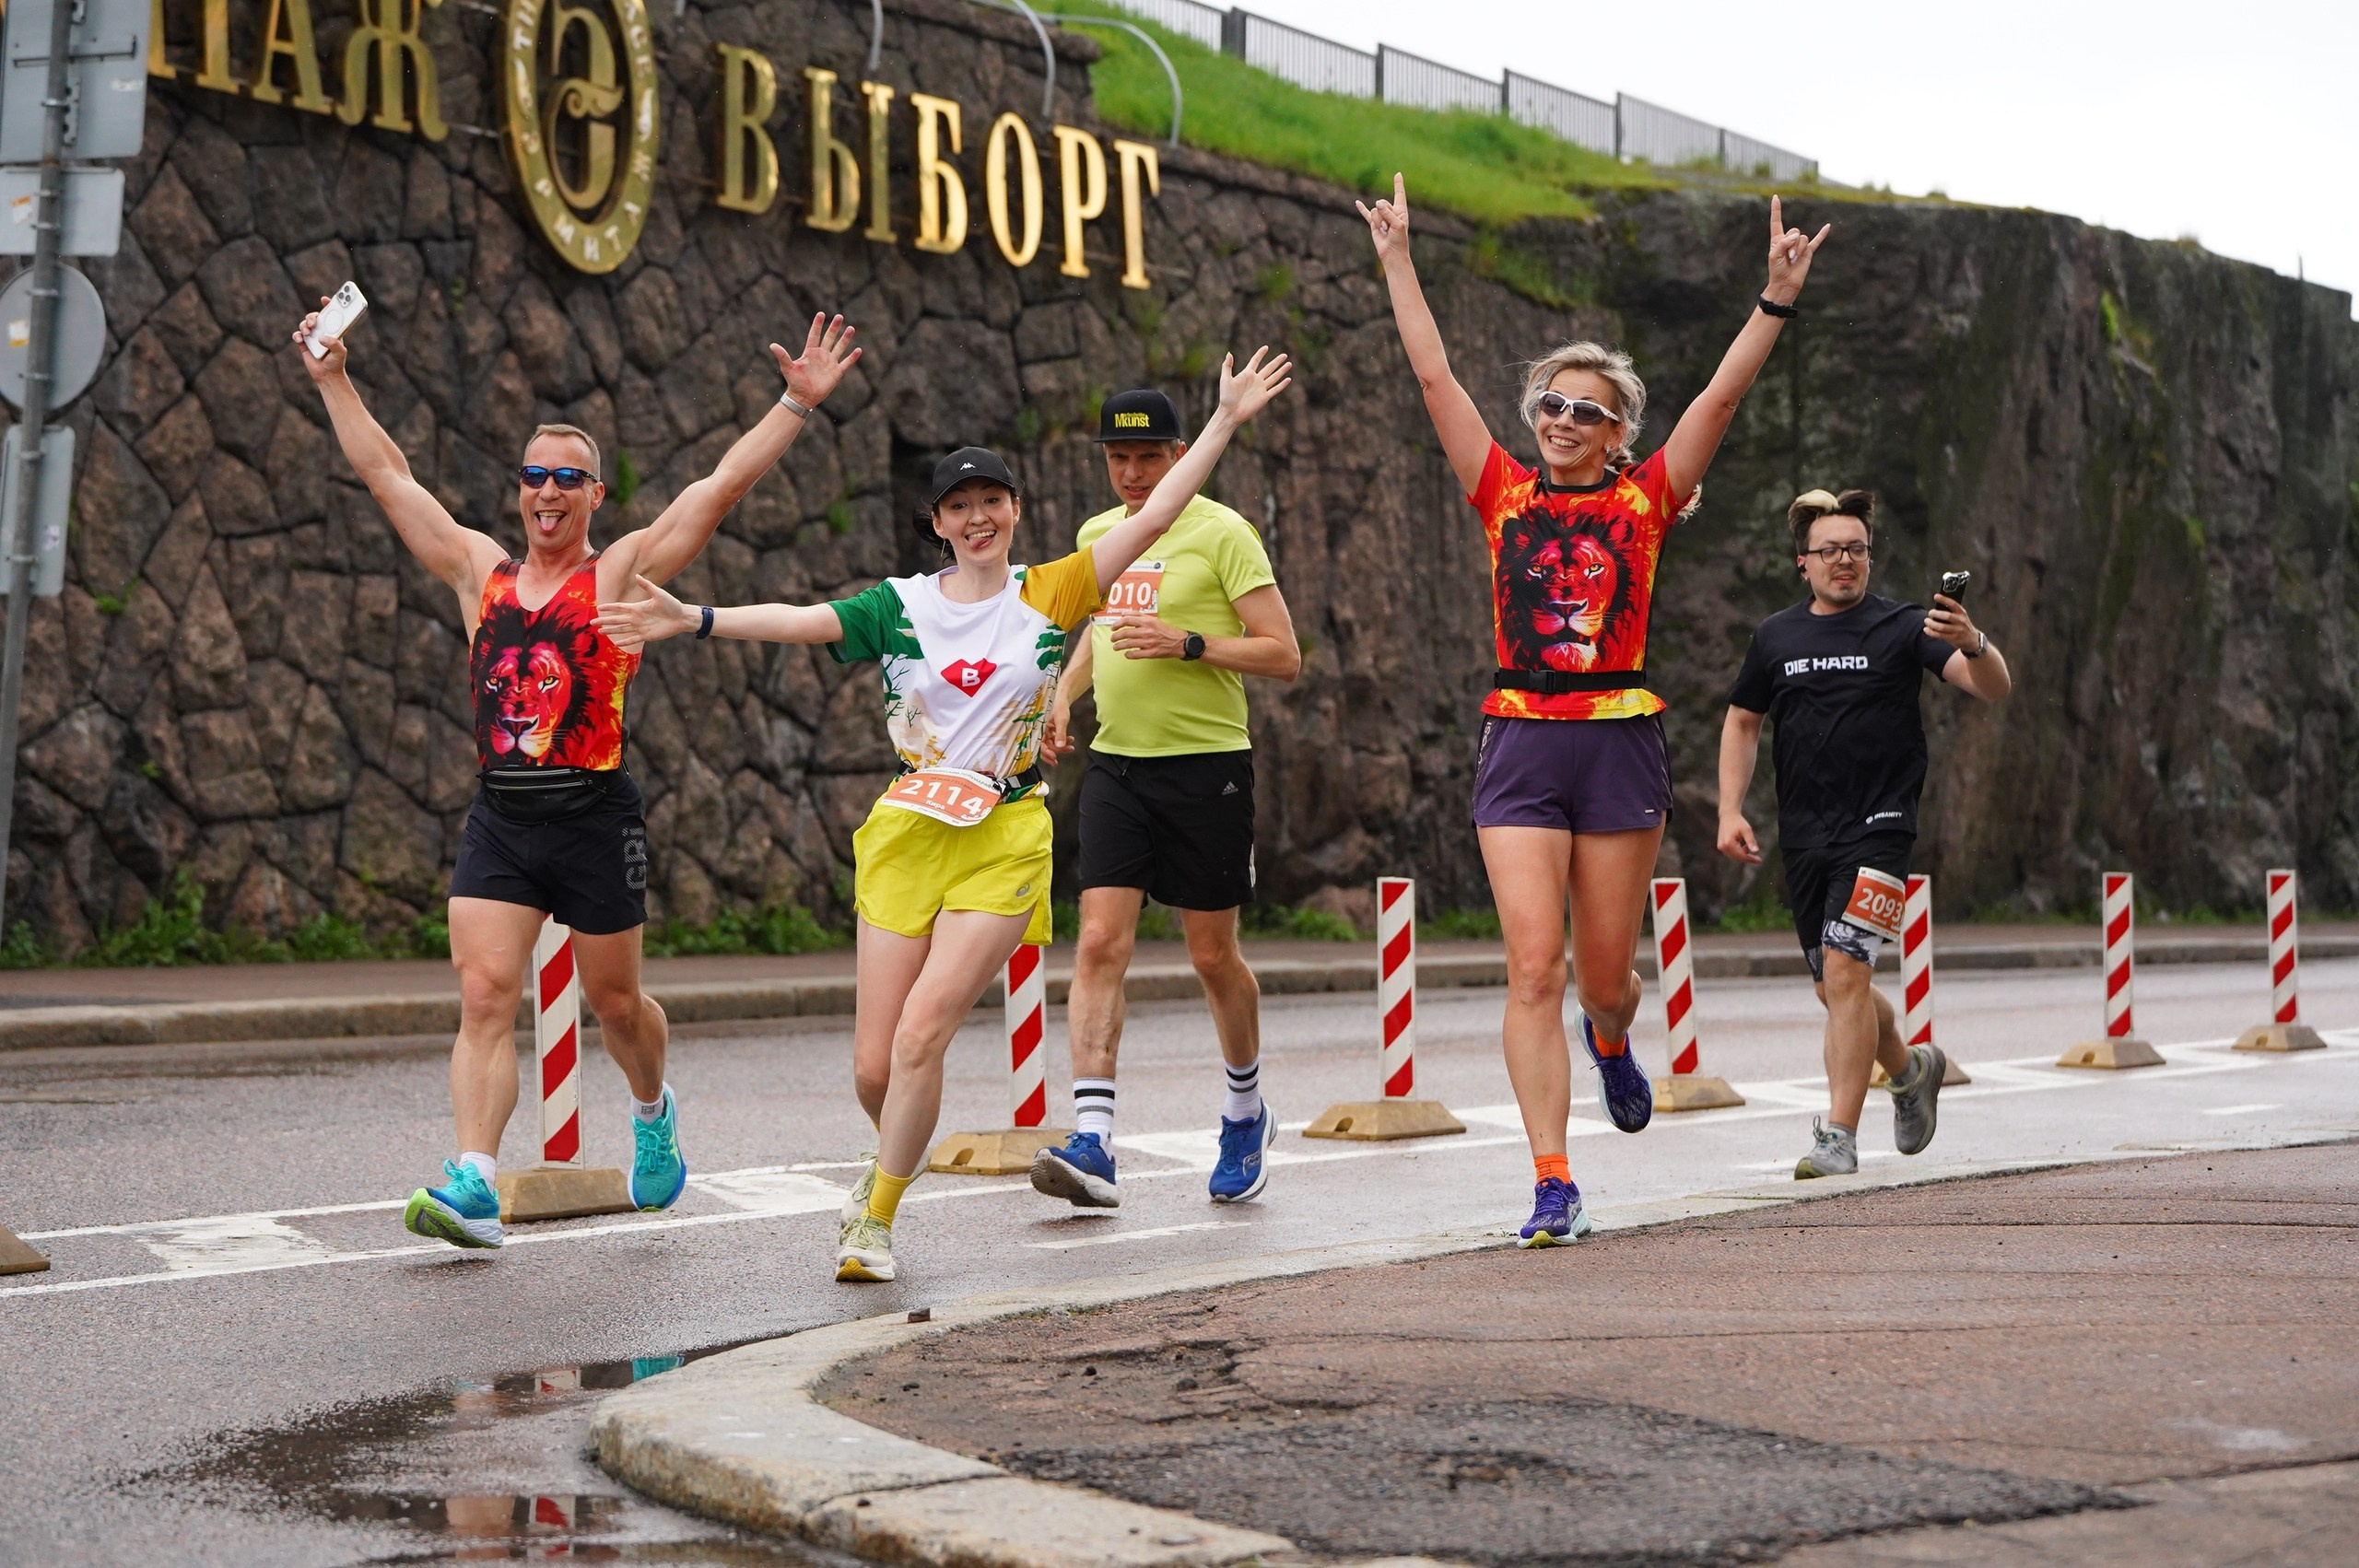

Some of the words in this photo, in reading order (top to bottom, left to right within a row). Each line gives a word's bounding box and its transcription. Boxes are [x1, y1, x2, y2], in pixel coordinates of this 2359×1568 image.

[716, 42, 1159, 290] ВЫБОРГ
[1108, 581, 1152, 605] 010
[1784, 658, 1810, 676] DIE
[1813, 655, 1869, 671] HARD
[898, 778, 984, 815] 2114
[925, 799, 945, 810] Кира
[1857, 887, 1902, 922] 2093
